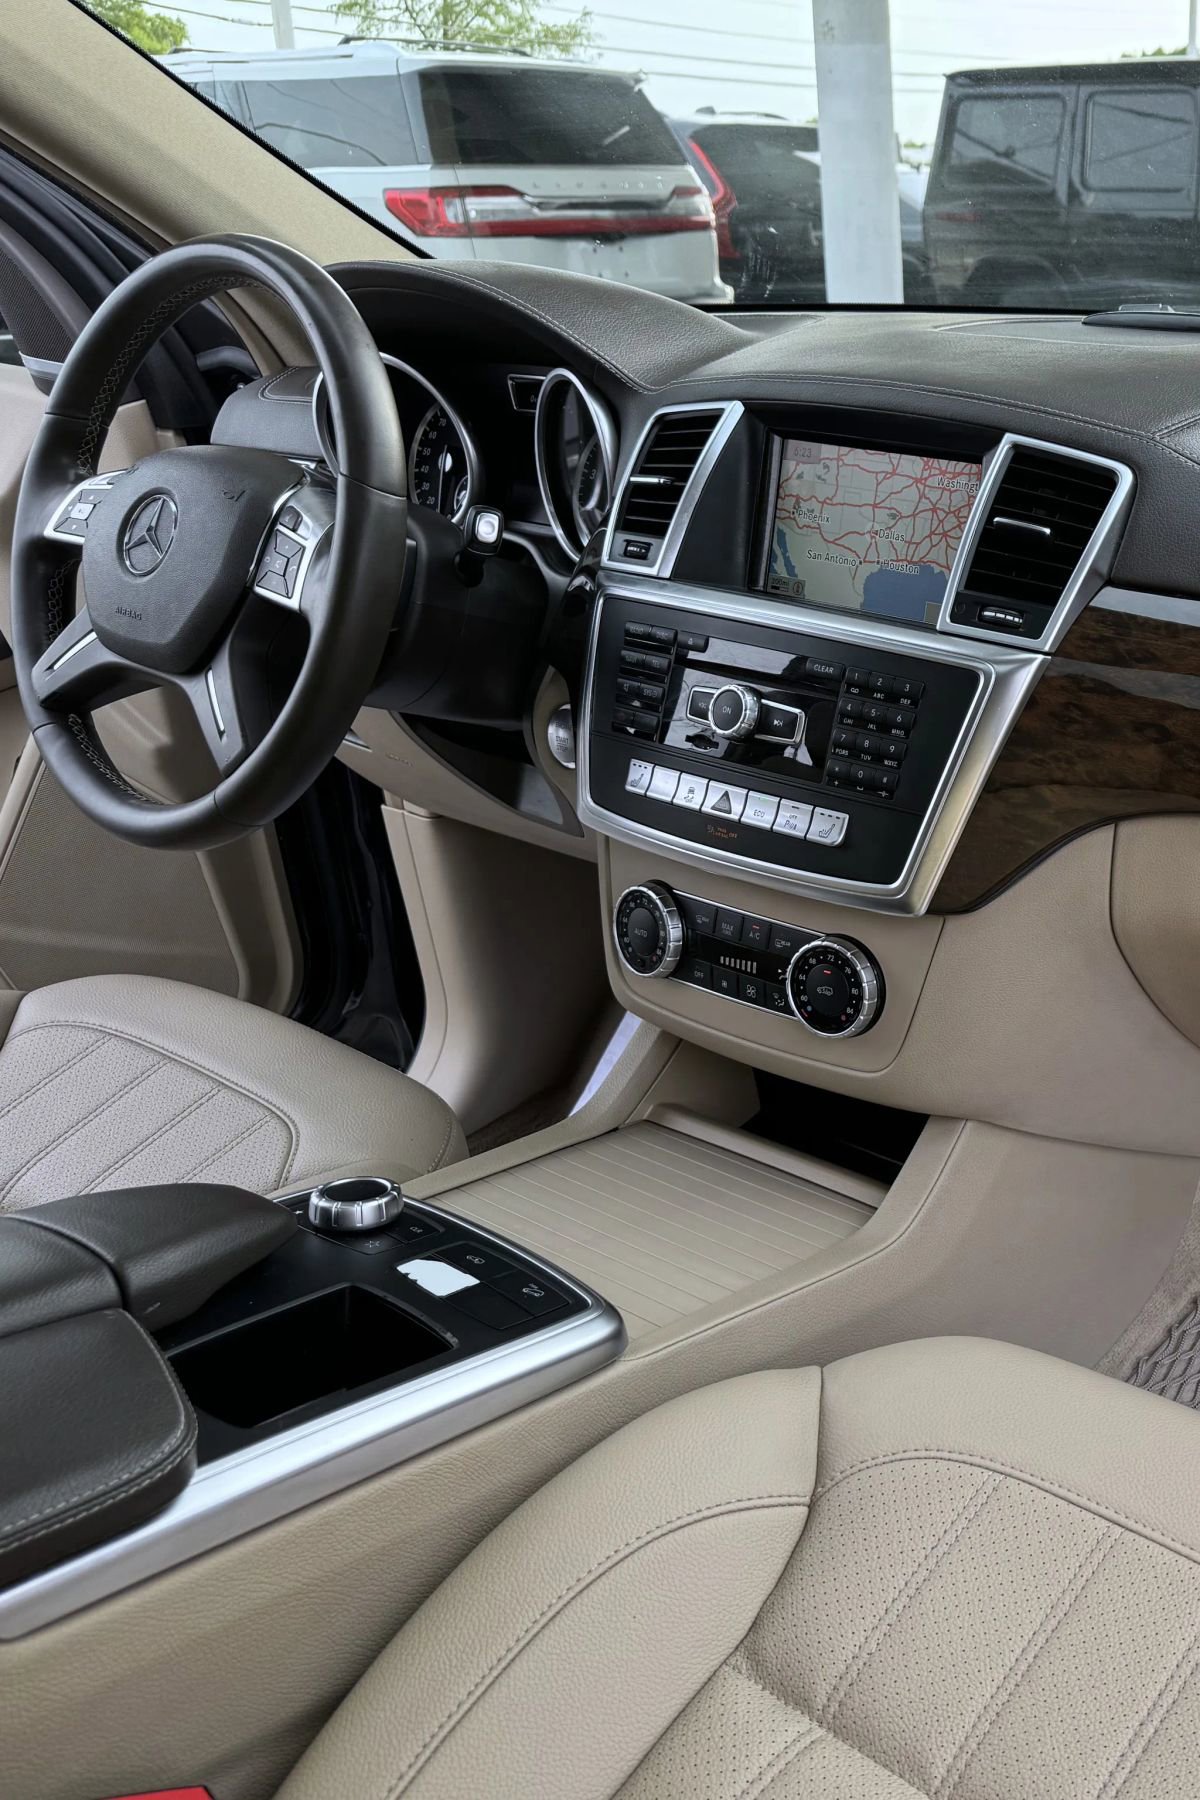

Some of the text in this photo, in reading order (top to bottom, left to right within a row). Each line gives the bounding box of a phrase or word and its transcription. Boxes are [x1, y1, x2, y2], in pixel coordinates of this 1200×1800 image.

[422, 447, 431, 456] 50
[420, 465, 429, 473] 40
[421, 482, 430, 490] 30
[937, 477, 980, 494] Washingt
[426, 496, 435, 504] 20
[797, 509, 830, 523] Phoenix
[878, 528, 905, 542] Dallas
[806, 549, 857, 567] San Antonio
[883, 560, 919, 574] Houston
[115, 606, 142, 620] AIRBAG
[813, 664, 834, 674] CLEAR
[877, 678, 883, 686] 2
[904, 684, 910, 692] 3
[873, 692, 885, 700] ABC
[722, 705, 732, 714] ON
[846, 703, 852, 711] 4
[871, 708, 876, 717] 5
[896, 714, 902, 723] 6
[841, 734, 846, 742] 7
[864, 740, 869, 748] 8
[889, 745, 895, 753] 9
[861, 753, 872, 761] TUV
[753, 810, 765, 818] ECO
[721, 922, 735, 931] MAX
[634, 928, 648, 938] AUTO
[749, 931, 760, 940] A/C
[827, 954, 835, 962] 72
[694, 970, 704, 979] OFF
